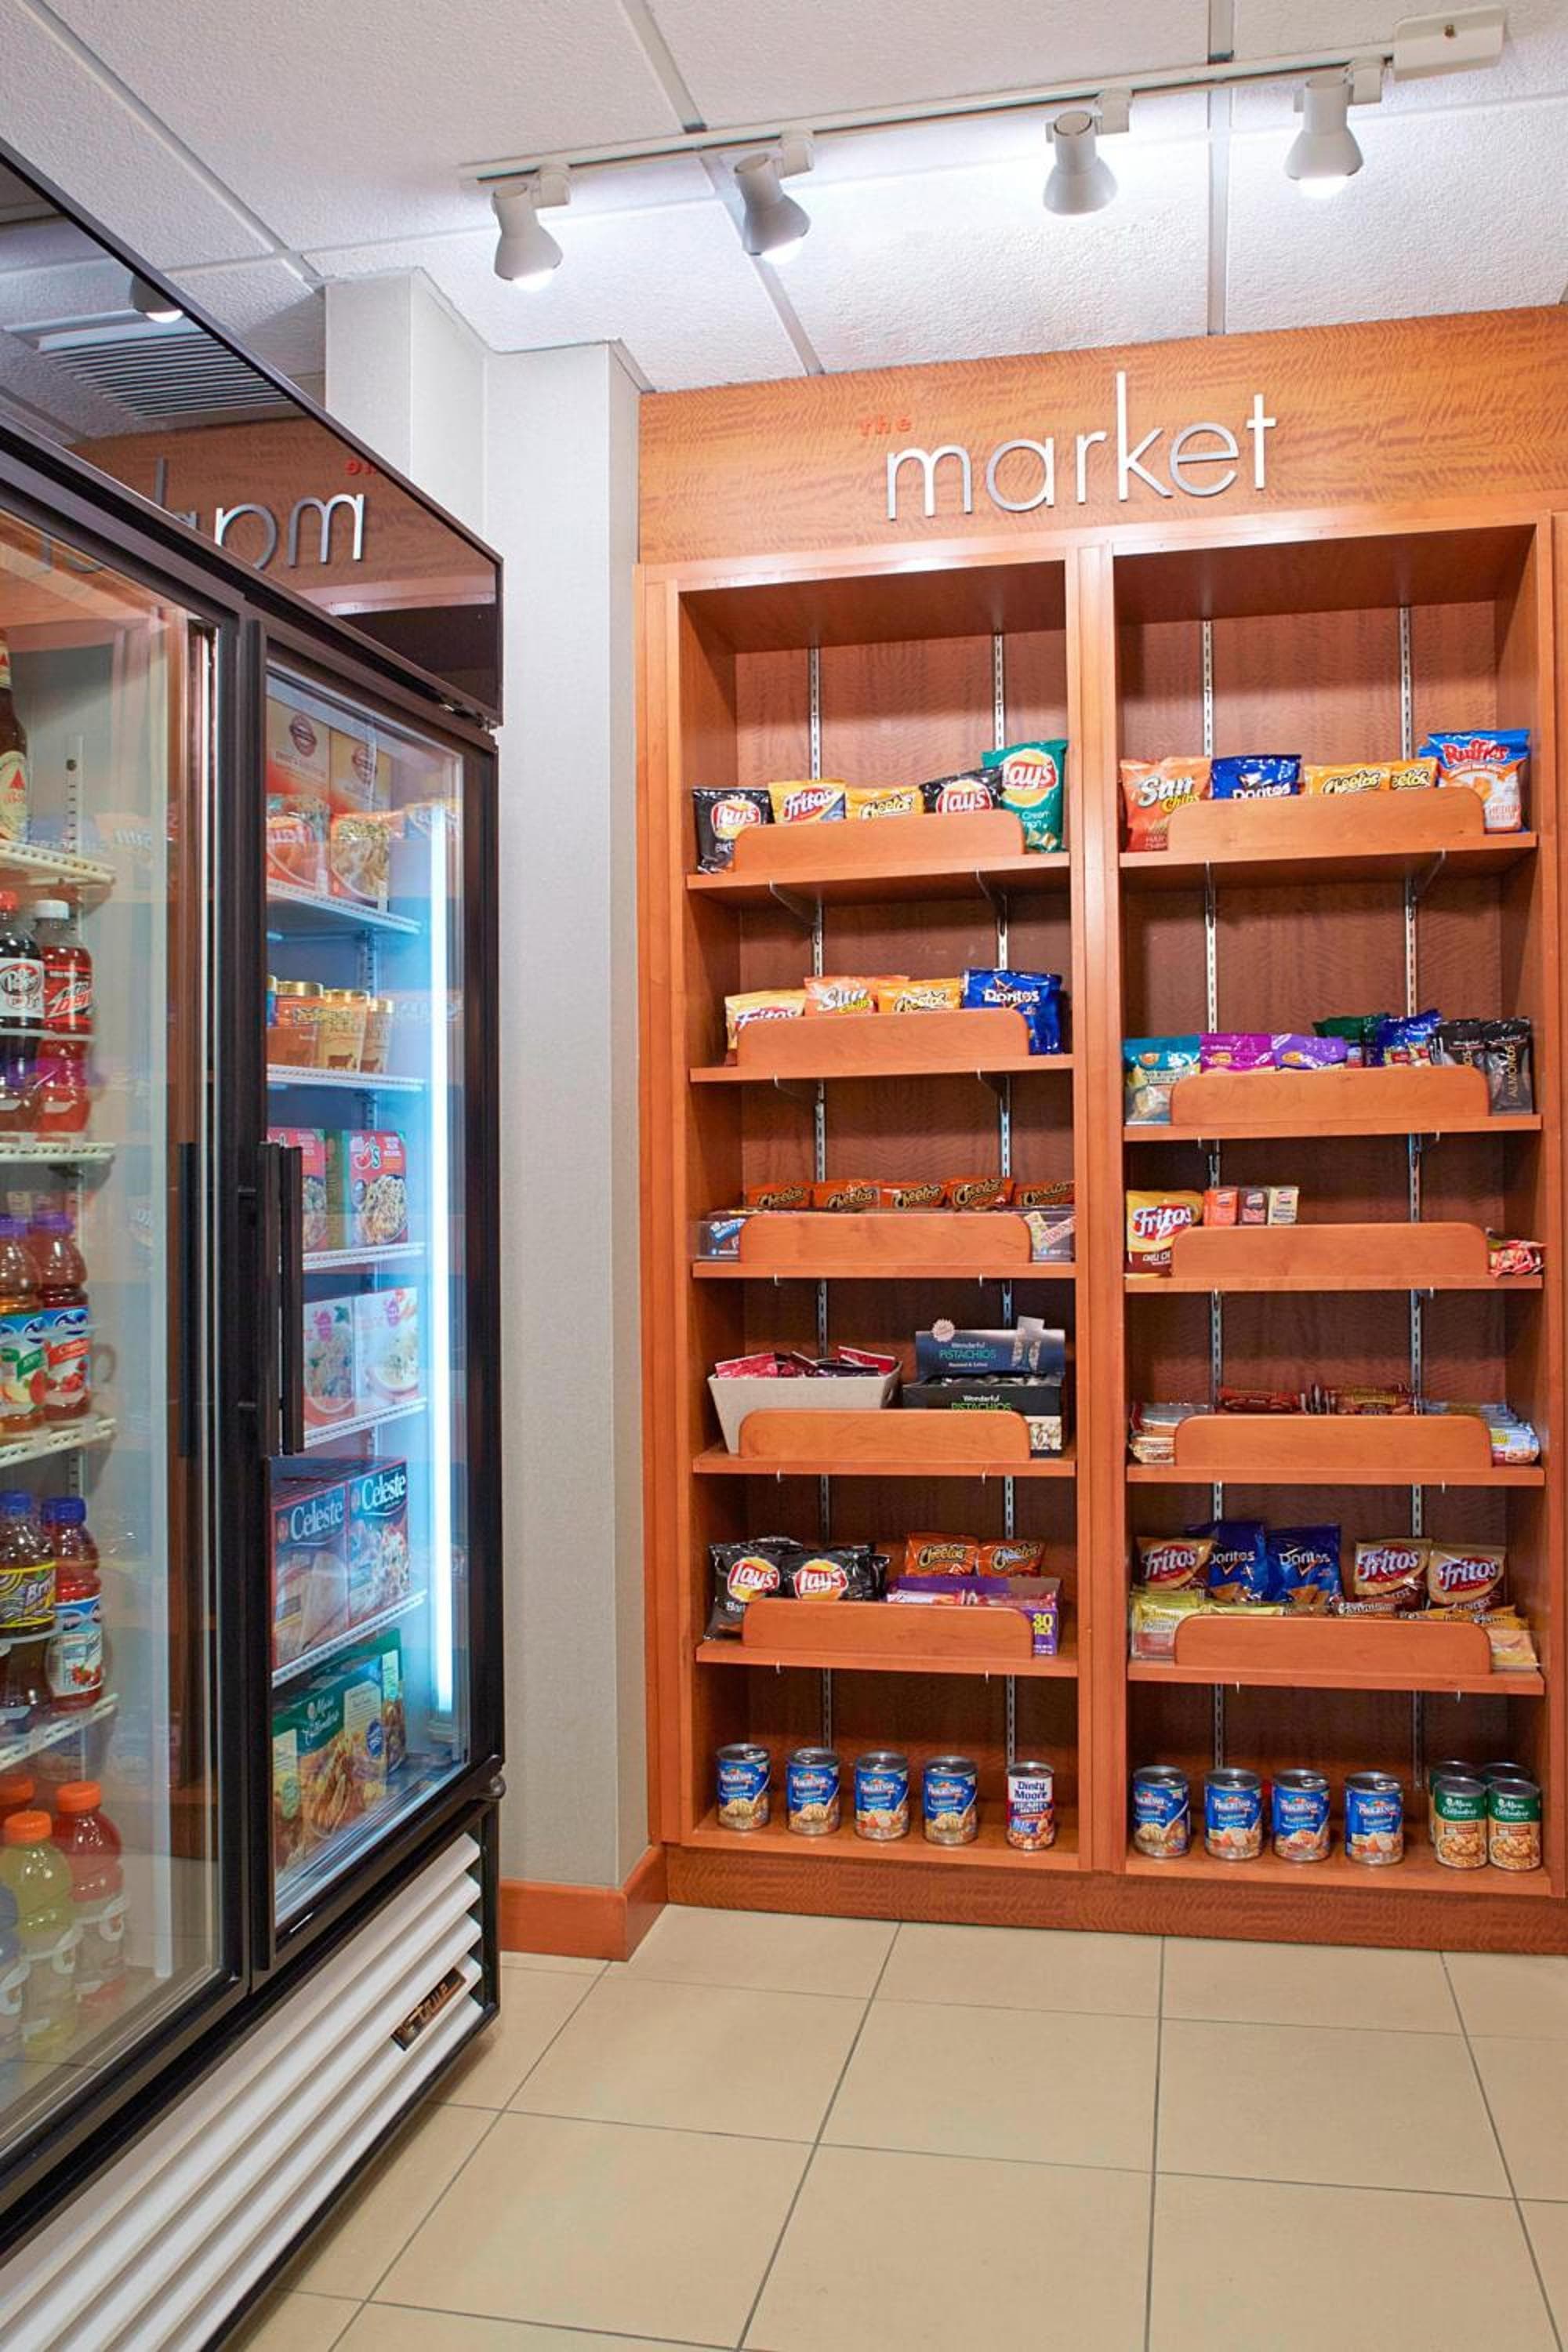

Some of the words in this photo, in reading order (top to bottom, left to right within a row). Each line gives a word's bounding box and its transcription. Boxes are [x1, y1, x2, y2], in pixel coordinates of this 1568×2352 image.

[886, 371, 1277, 521] market
[1442, 739, 1510, 765] Ruffles
[1138, 775, 1193, 808] Sun
[1232, 782, 1299, 799] Doritos
[785, 788, 836, 821] Fritos
[983, 988, 1040, 1003] Doritos
[759, 1186, 806, 1207] Cheetos
[827, 1187, 875, 1210] Cheetos
[894, 1185, 940, 1210] Cheetos
[1133, 1206, 1194, 1241] Fritos
[361, 1472, 407, 1510] Celeste
[291, 1498, 344, 1541] Celeste
[919, 1542, 967, 1568] Cheetos
[993, 1543, 1042, 1569] Cheetos
[1142, 1548, 1196, 1579] Fritos
[1279, 1550, 1333, 1565] Doritos
[1357, 1548, 1419, 1580] Fritos
[1439, 1559, 1499, 1591] Fritos
[1014, 1789, 1047, 1799] Moore
[1017, 1780, 1045, 1791] Dinty
